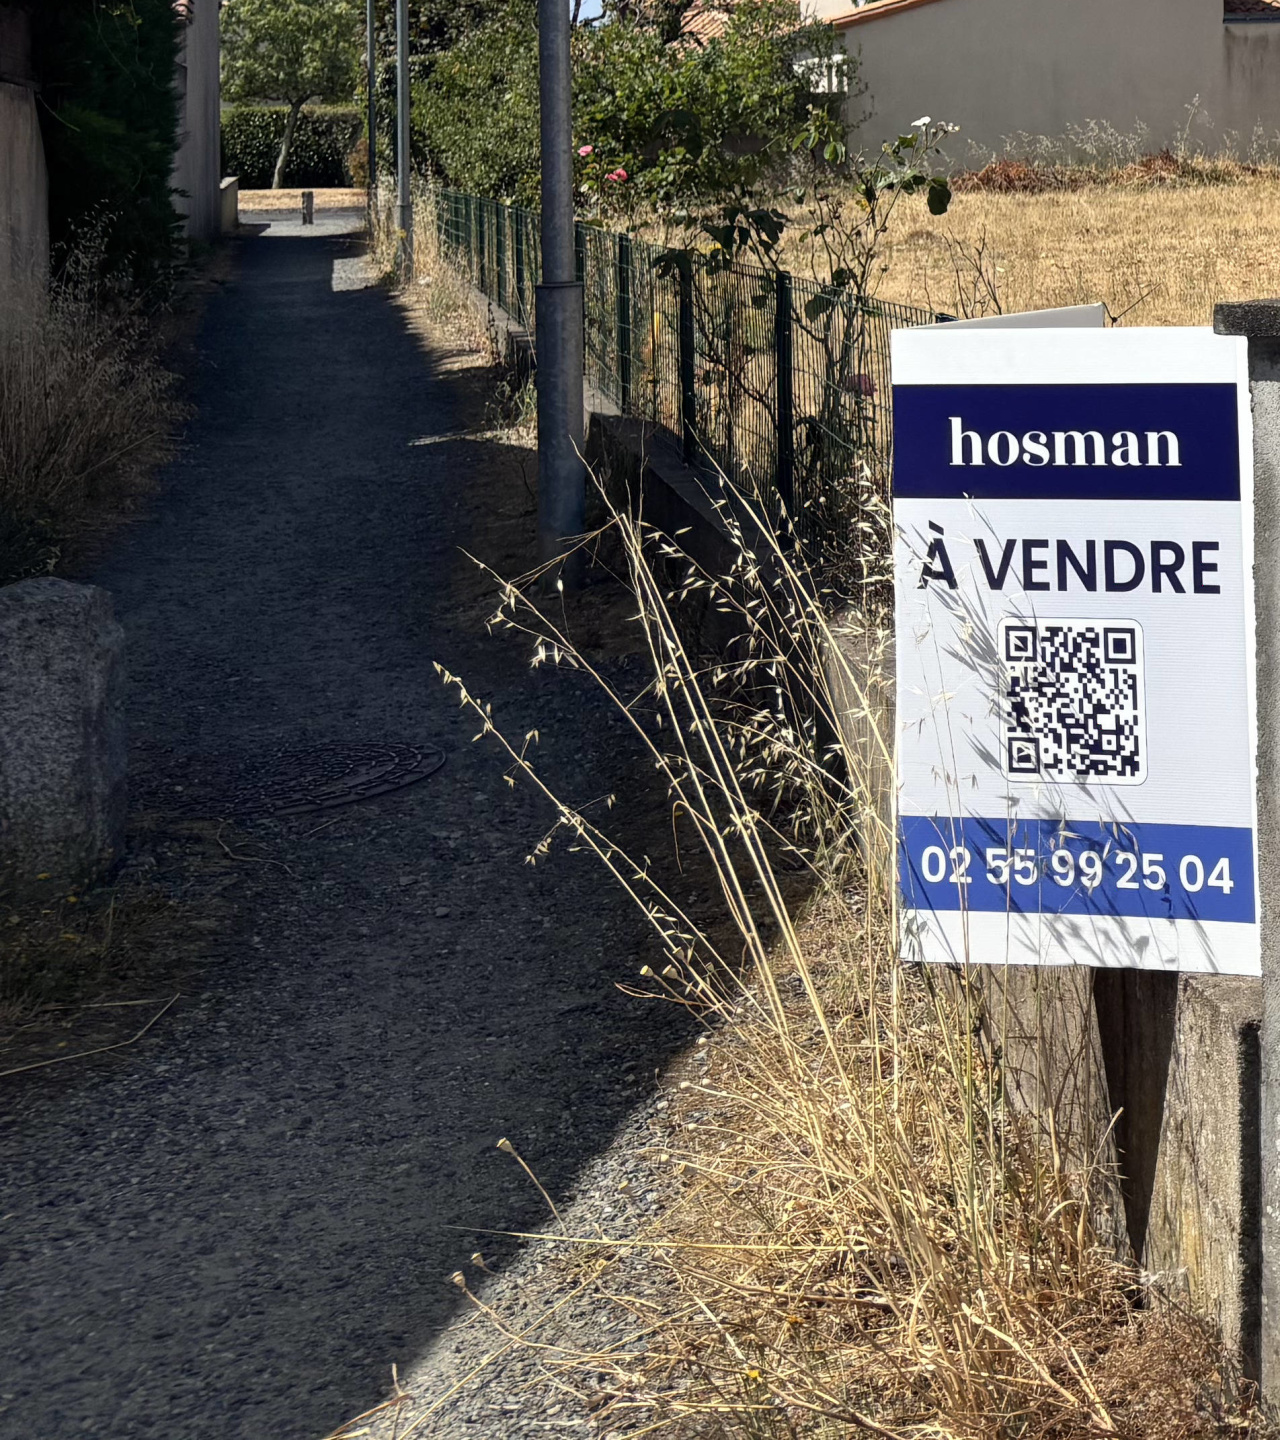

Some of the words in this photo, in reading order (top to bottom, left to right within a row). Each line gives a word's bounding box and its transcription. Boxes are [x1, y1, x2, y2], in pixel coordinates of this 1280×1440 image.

[948, 416, 1183, 467] hosman
[917, 520, 959, 590] À
[973, 538, 1221, 595] VENDRE
[921, 845, 972, 885] 02
[986, 847, 1038, 886] 55
[1051, 849, 1104, 888] 99
[1115, 851, 1167, 891] 25
[1179, 854, 1235, 895] 04
